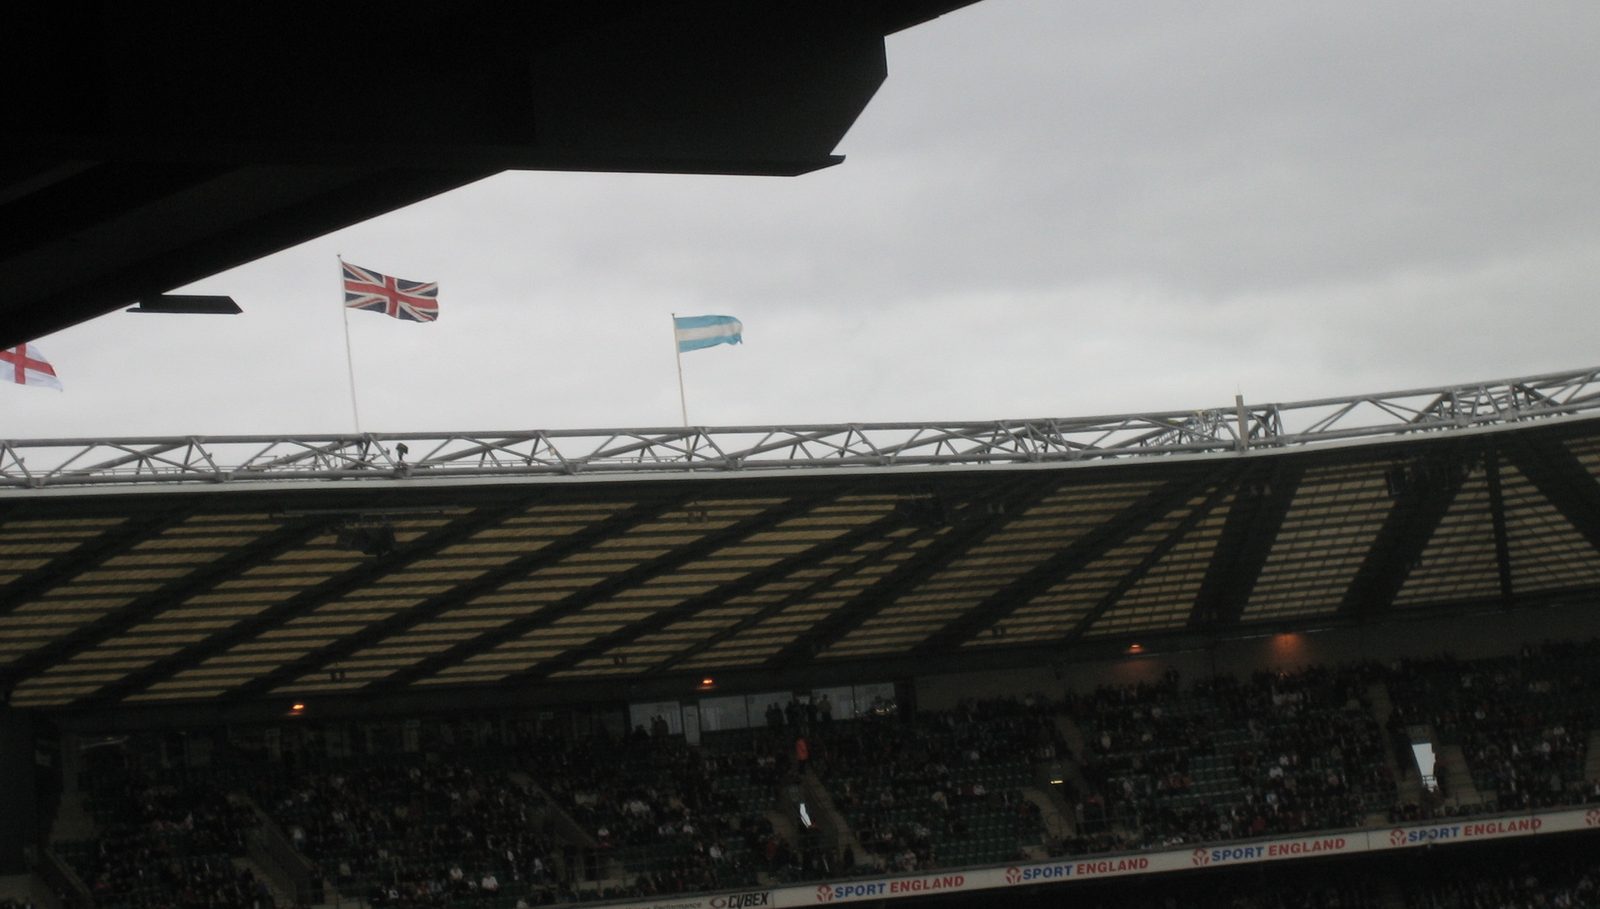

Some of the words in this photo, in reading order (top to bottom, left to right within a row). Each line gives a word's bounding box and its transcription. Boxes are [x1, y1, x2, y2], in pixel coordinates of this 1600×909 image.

[1409, 827, 1459, 842] SPORT
[1464, 819, 1542, 836] ENGLAND
[1212, 847, 1264, 861] SPORT
[1268, 838, 1345, 856] ENGLAND
[1023, 865, 1073, 880] SPORT
[1076, 858, 1148, 875] ENGLAND
[834, 883, 886, 898] SPORT
[890, 876, 965, 893] ENGLAND
[728, 892, 769, 909] CYBEX
